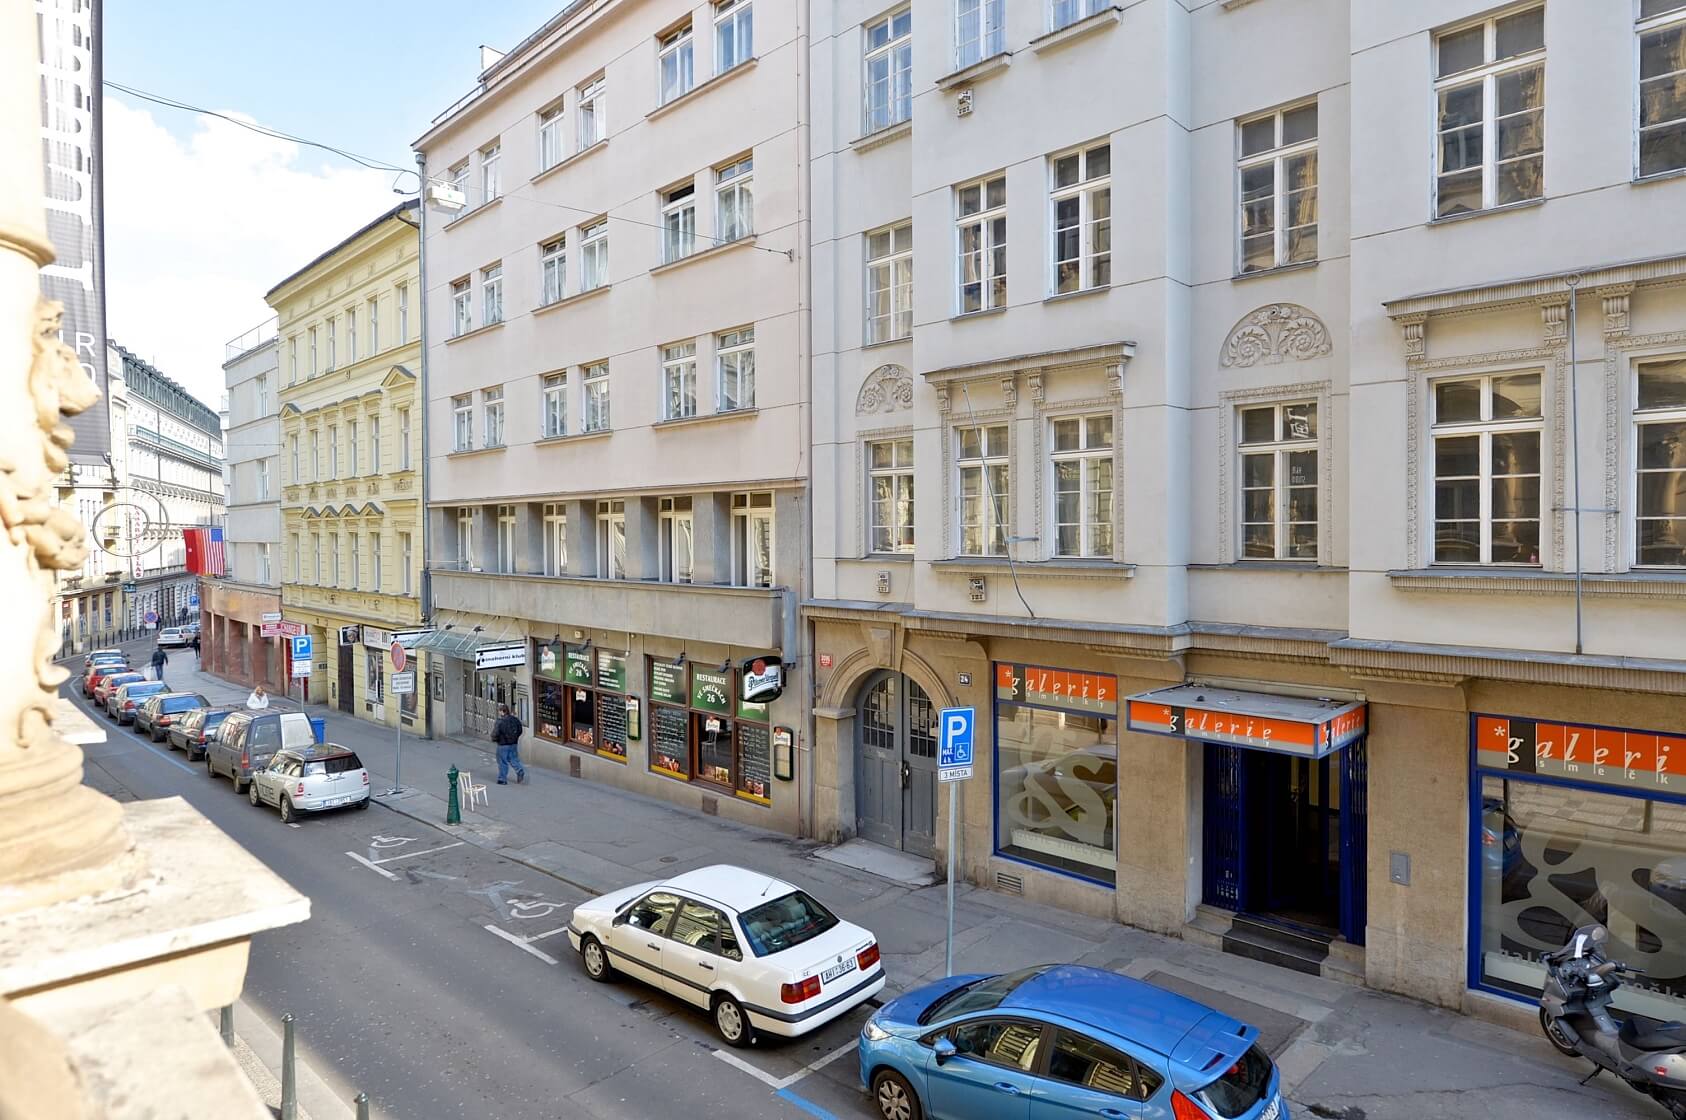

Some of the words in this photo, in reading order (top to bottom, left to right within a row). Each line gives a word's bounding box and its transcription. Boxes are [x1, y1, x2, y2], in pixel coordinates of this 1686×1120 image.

[296, 639, 308, 653] P
[696, 673, 727, 685] RESTAURACE
[707, 694, 716, 703] 26
[947, 716, 967, 748] P
